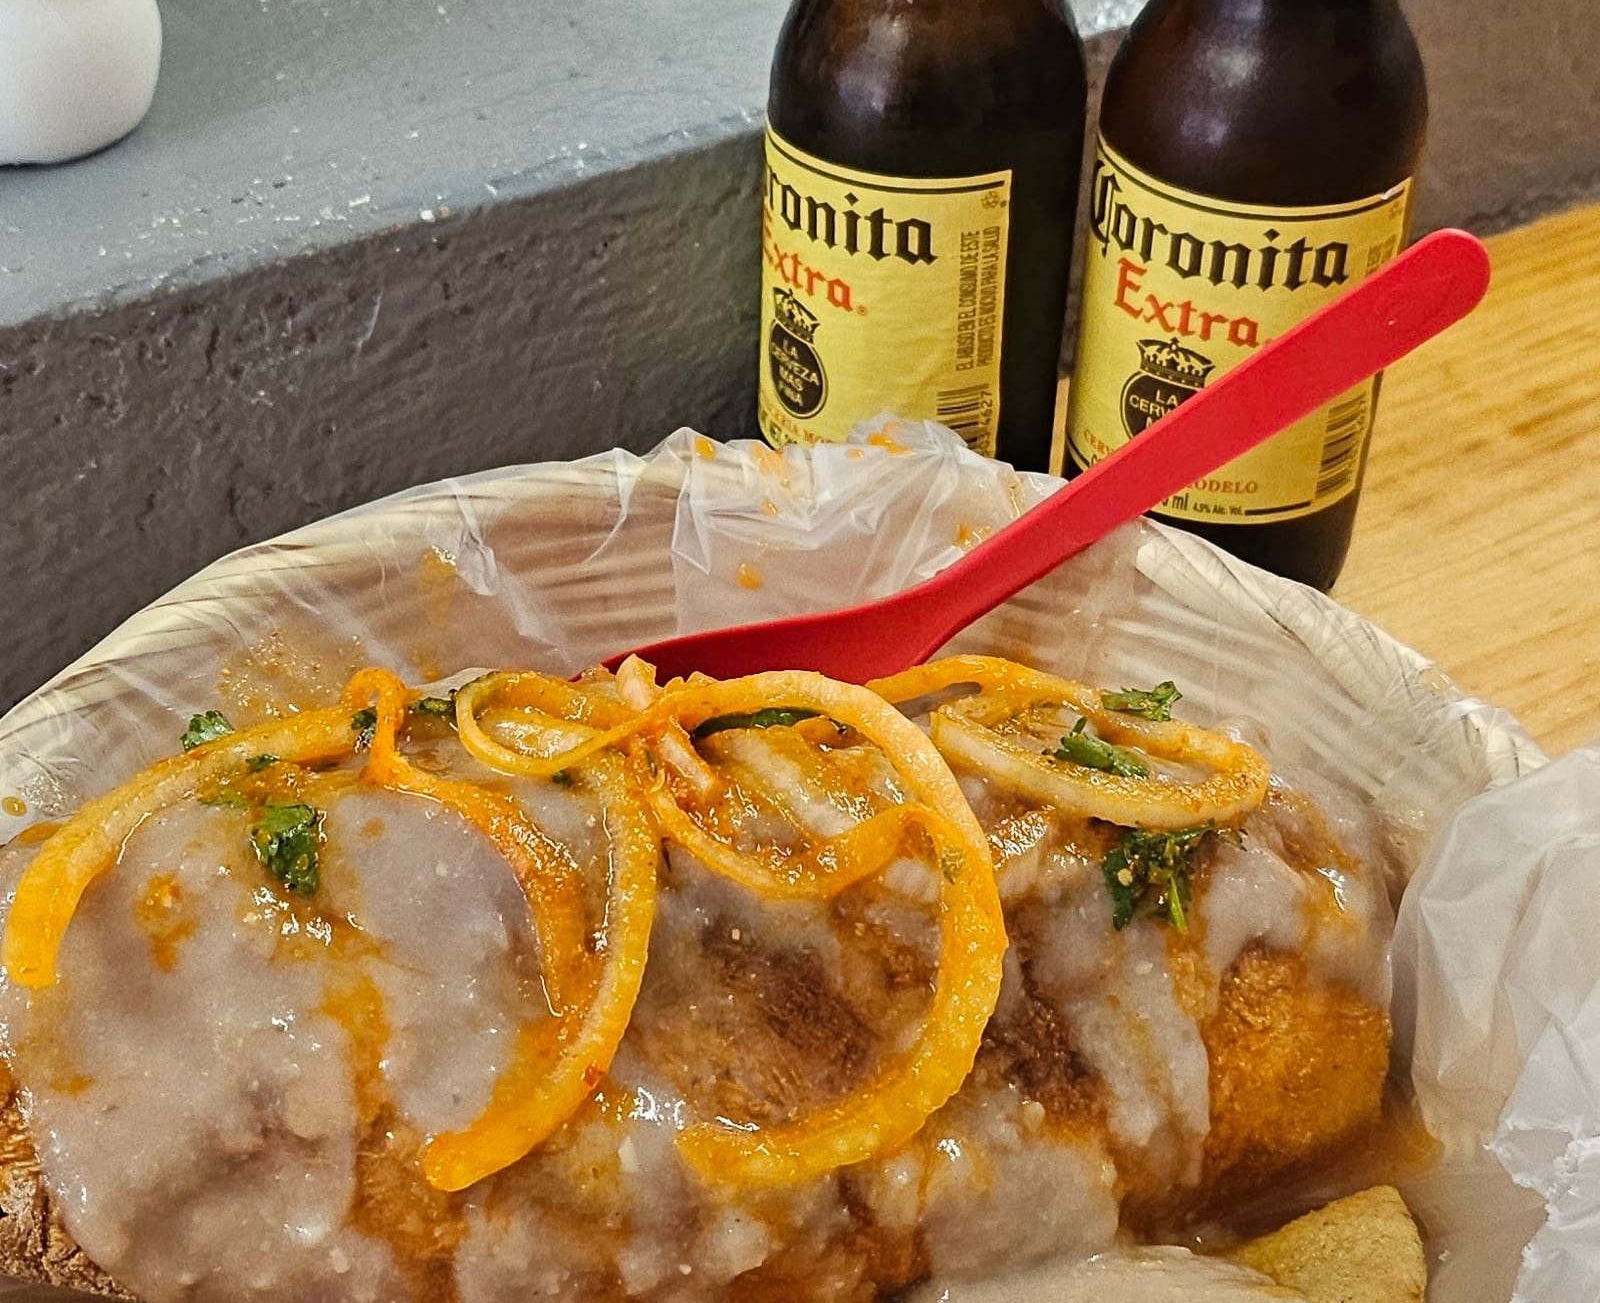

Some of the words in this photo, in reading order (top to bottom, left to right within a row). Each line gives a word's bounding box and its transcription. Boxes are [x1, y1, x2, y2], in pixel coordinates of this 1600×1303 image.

[767, 165, 938, 266] ronita
[1090, 160, 1349, 292] Coronita
[960, 231, 980, 252] ESTE
[982, 226, 1000, 252] SALUD
[960, 252, 979, 265] DE
[958, 307, 977, 319] EL
[1114, 257, 1261, 348] Extra
[956, 359, 975, 371] EL
[980, 390, 993, 426] 4627
[1129, 395, 1172, 418] CERV
[1156, 390, 1178, 407] LA
[1187, 479, 1258, 494] ODELO
[1172, 493, 1189, 511] ml
